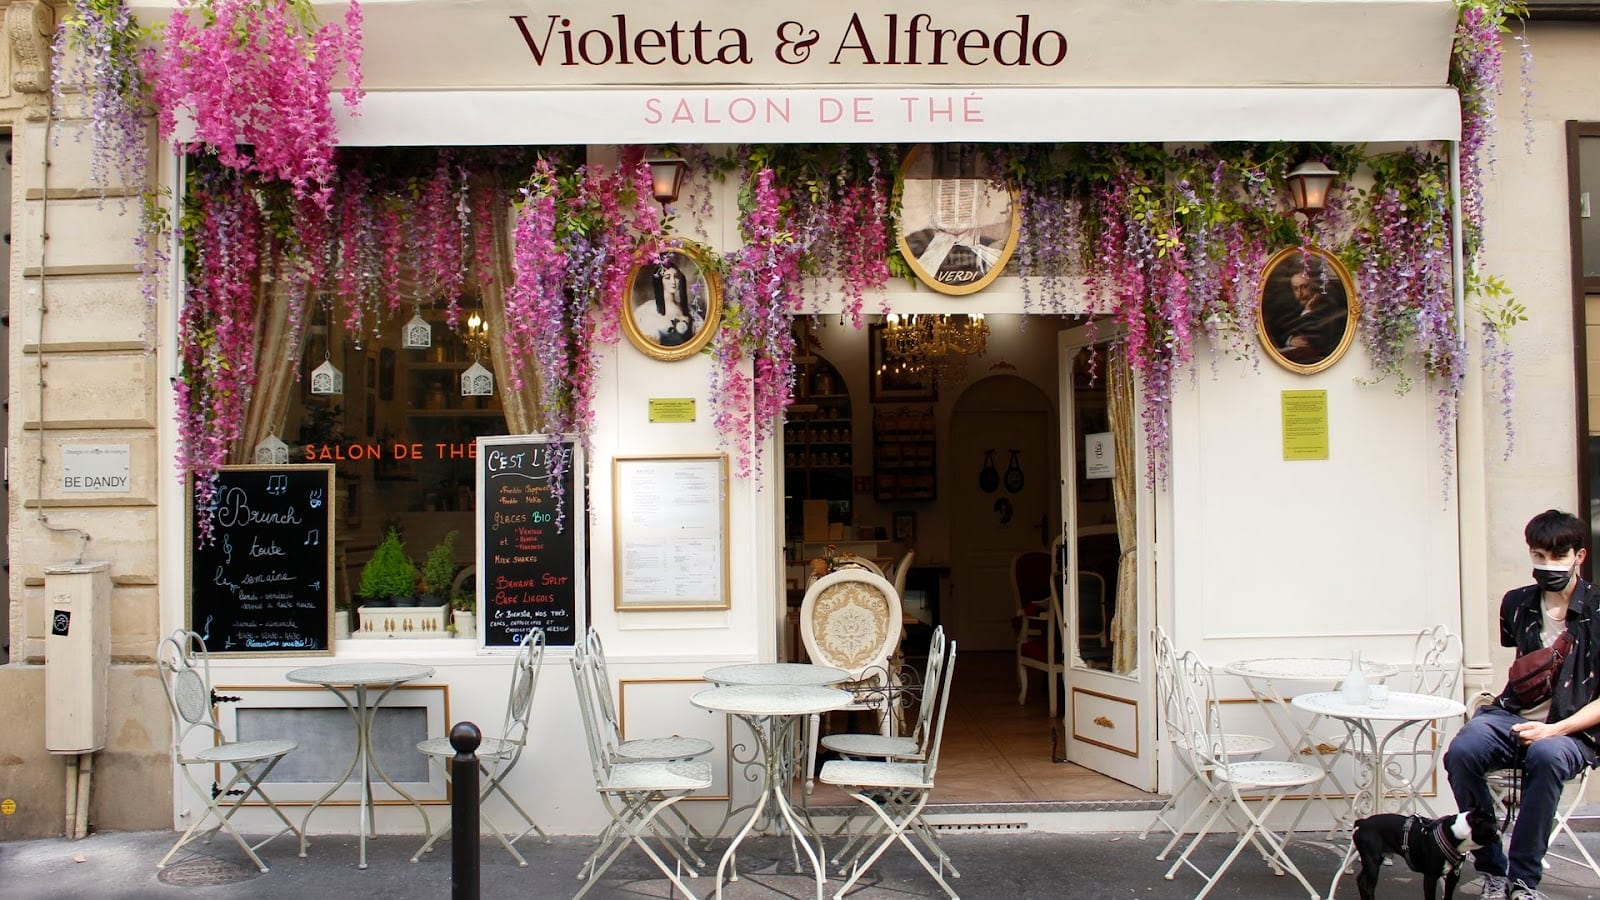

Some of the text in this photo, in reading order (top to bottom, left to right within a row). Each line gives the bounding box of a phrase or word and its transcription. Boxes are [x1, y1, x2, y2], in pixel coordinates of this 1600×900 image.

[509, 12, 1068, 67] Violetta & Alfredo
[644, 91, 984, 124] SALON DE THÉ
[937, 270, 979, 281] VERDI
[304, 443, 381, 461] SALON
[394, 443, 423, 460] DE
[64, 476, 127, 488] BE DANDY
[218, 487, 303, 528] Brunch
[532, 511, 551, 523] BIO
[248, 535, 287, 557] toute
[500, 536, 509, 546] et
[241, 570, 297, 584] semaine
[541, 572, 569, 586] SPLIT
